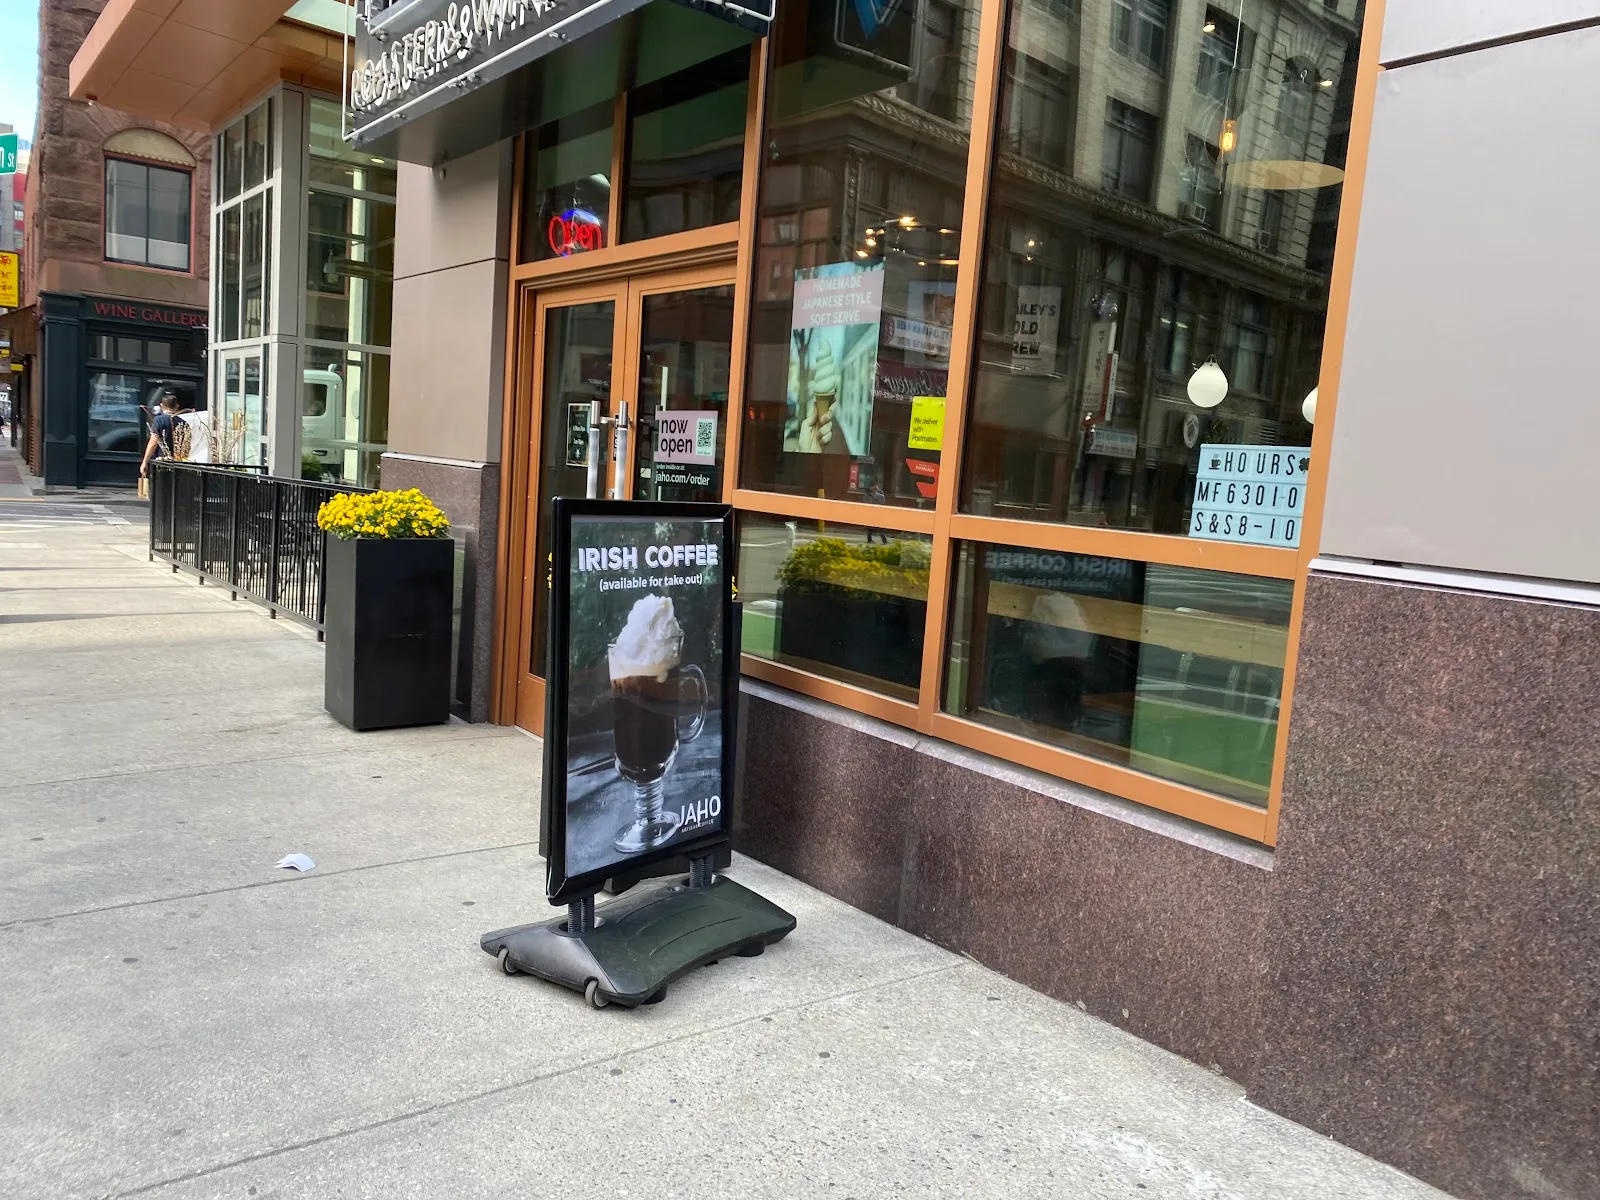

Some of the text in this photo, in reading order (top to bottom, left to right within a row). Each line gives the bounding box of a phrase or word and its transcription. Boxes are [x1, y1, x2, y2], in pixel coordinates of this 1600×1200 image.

[7, 152, 15, 168] St
[548, 215, 603, 257] Open
[812, 275, 862, 293] HOMEMADE
[802, 291, 872, 310] JAPANESE STYLE
[94, 302, 208, 326] WINE GALLERY
[809, 310, 861, 326] SOFT SERVE
[1019, 303, 1057, 317] ILEY'S
[1014, 320, 1039, 335] OLD
[1013, 341, 1041, 356] REW
[660, 418, 689, 434] now
[913, 417, 921, 425] We
[911, 434, 939, 443] Postmates.
[660, 437, 693, 458] open
[1224, 451, 1296, 476] HOURS
[654, 470, 711, 487] jaho.com/order
[578, 544, 719, 572] IRISH COFFEE
[599, 573, 703, 592] (available for take out)
[678, 795, 721, 828] JAHO
